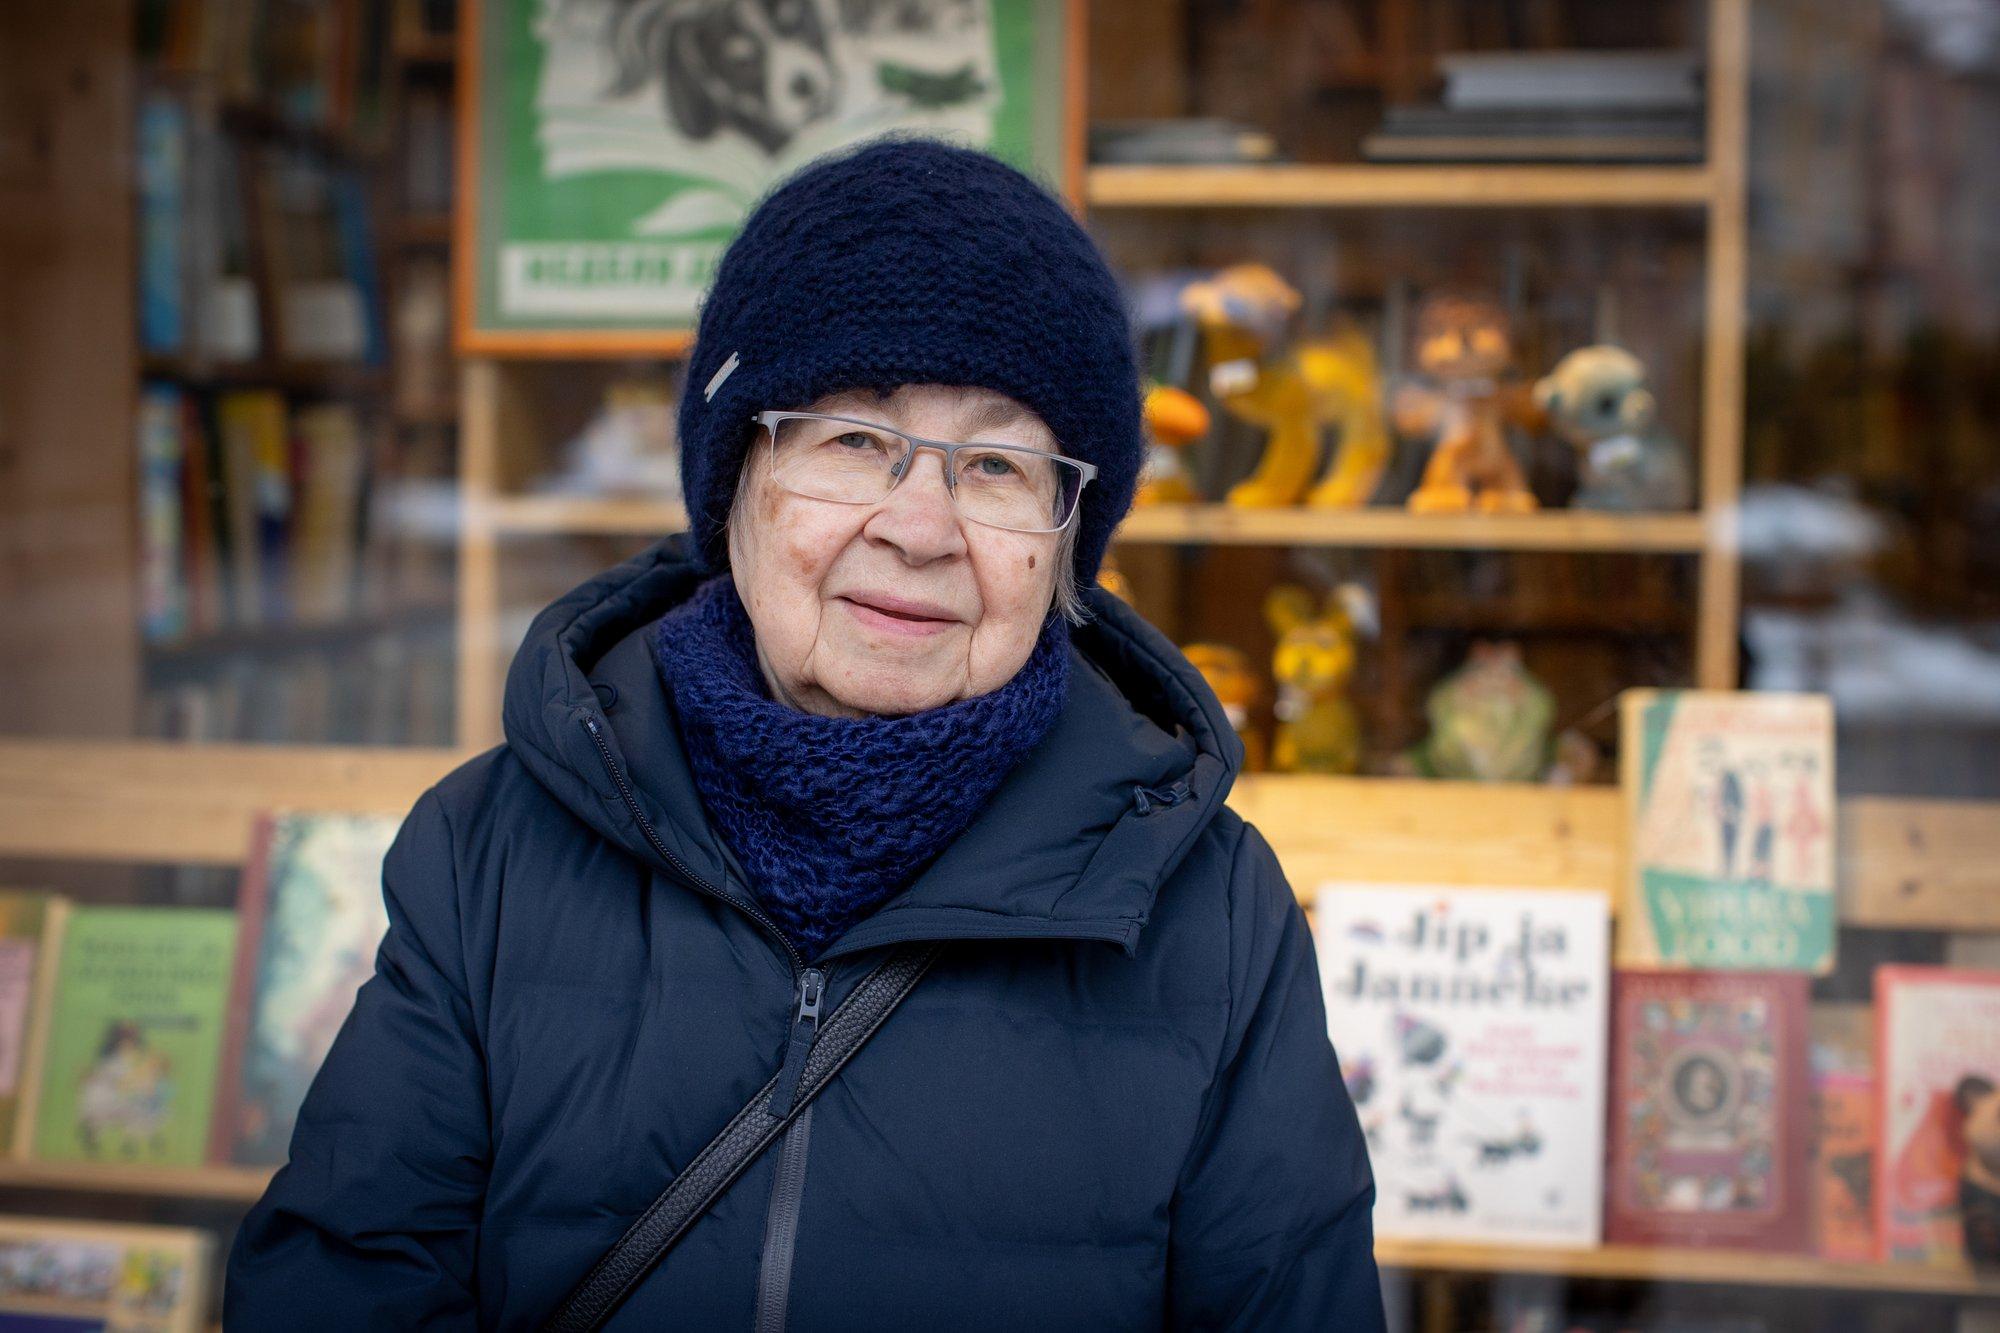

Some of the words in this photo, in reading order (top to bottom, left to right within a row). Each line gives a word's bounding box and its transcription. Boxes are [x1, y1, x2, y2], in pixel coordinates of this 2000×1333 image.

[525, 254, 674, 286] НЕДЕЛЯ
[1402, 902, 1489, 961] Jip
[1507, 912, 1567, 956] ja
[1336, 958, 1588, 1004] Janneke
